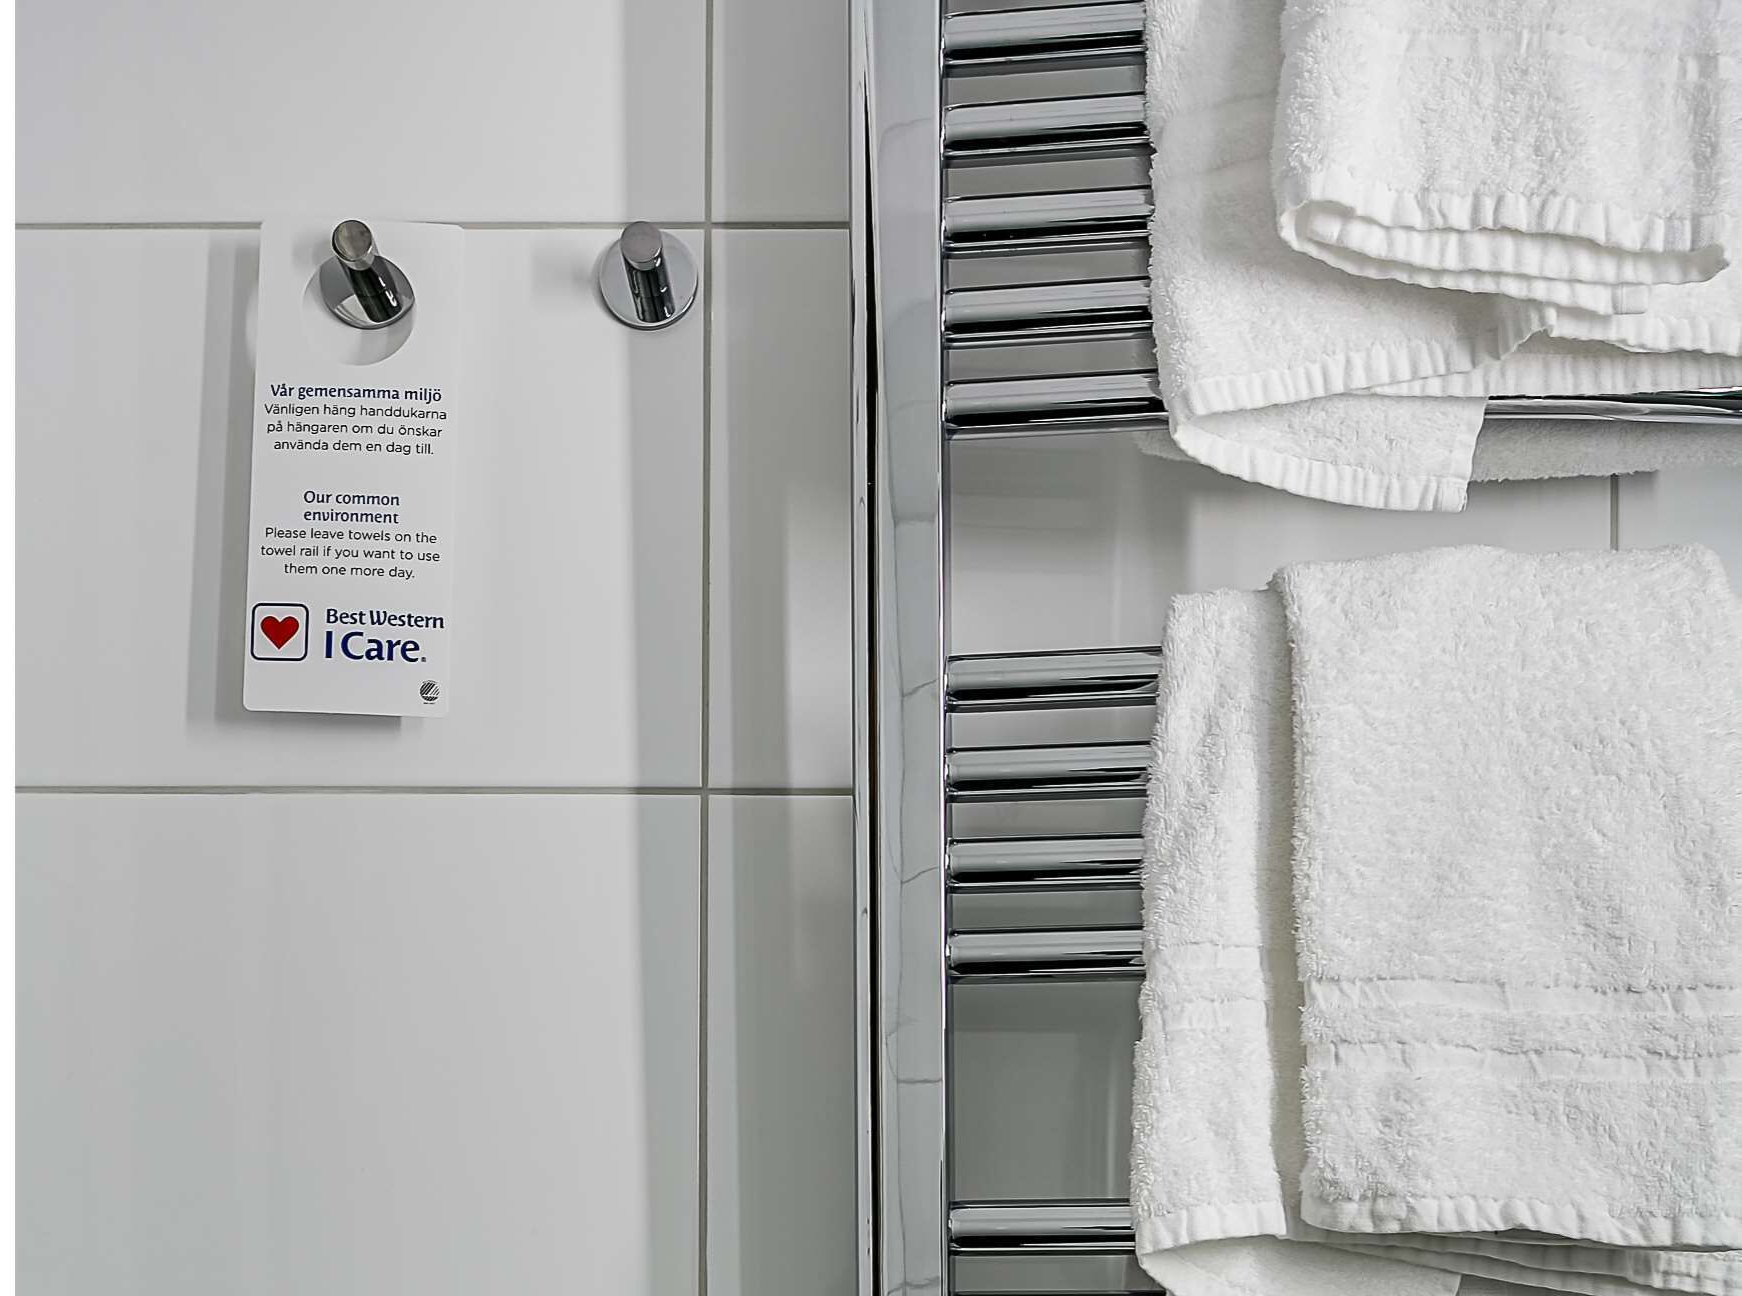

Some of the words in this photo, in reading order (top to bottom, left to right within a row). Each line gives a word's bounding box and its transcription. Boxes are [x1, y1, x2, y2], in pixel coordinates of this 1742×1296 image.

[271, 384, 294, 397] Vår
[298, 386, 399, 401] gemensamma
[404, 388, 442, 404] miljö
[265, 404, 319, 416] Vänligen
[323, 405, 356, 417] häng
[360, 406, 447, 420] handdukarna
[267, 421, 283, 434] på
[287, 422, 348, 434] hängaren
[352, 425, 373, 434] om
[378, 424, 394, 435] du
[398, 425, 442, 437] önskar
[274, 440, 329, 450] använda
[333, 440, 362, 451] dem
[366, 442, 382, 452] en
[386, 442, 411, 456] dag
[416, 444, 434, 455] till.
[303, 491, 332, 504] Our
[335, 493, 400, 506] common
[303, 509, 399, 524] environment
[265, 528, 307, 539] Please
[310, 528, 344, 539] leave
[348, 530, 390, 542] towels
[395, 533, 411, 543] on
[416, 533, 437, 543] the
[261, 546, 296, 556] towel
[300, 546, 319, 557] rail
[323, 546, 331, 557] if
[335, 548, 359, 560] you
[363, 549, 395, 560] want
[400, 550, 413, 560] to
[417, 551, 440, 562] use
[284, 563, 317, 574] them
[322, 565, 346, 575] one
[351, 566, 385, 576] more
[389, 566, 415, 580] day.
[326, 608, 366, 625] Best
[369, 610, 444, 628] Western
[325, 631, 333, 658] I
